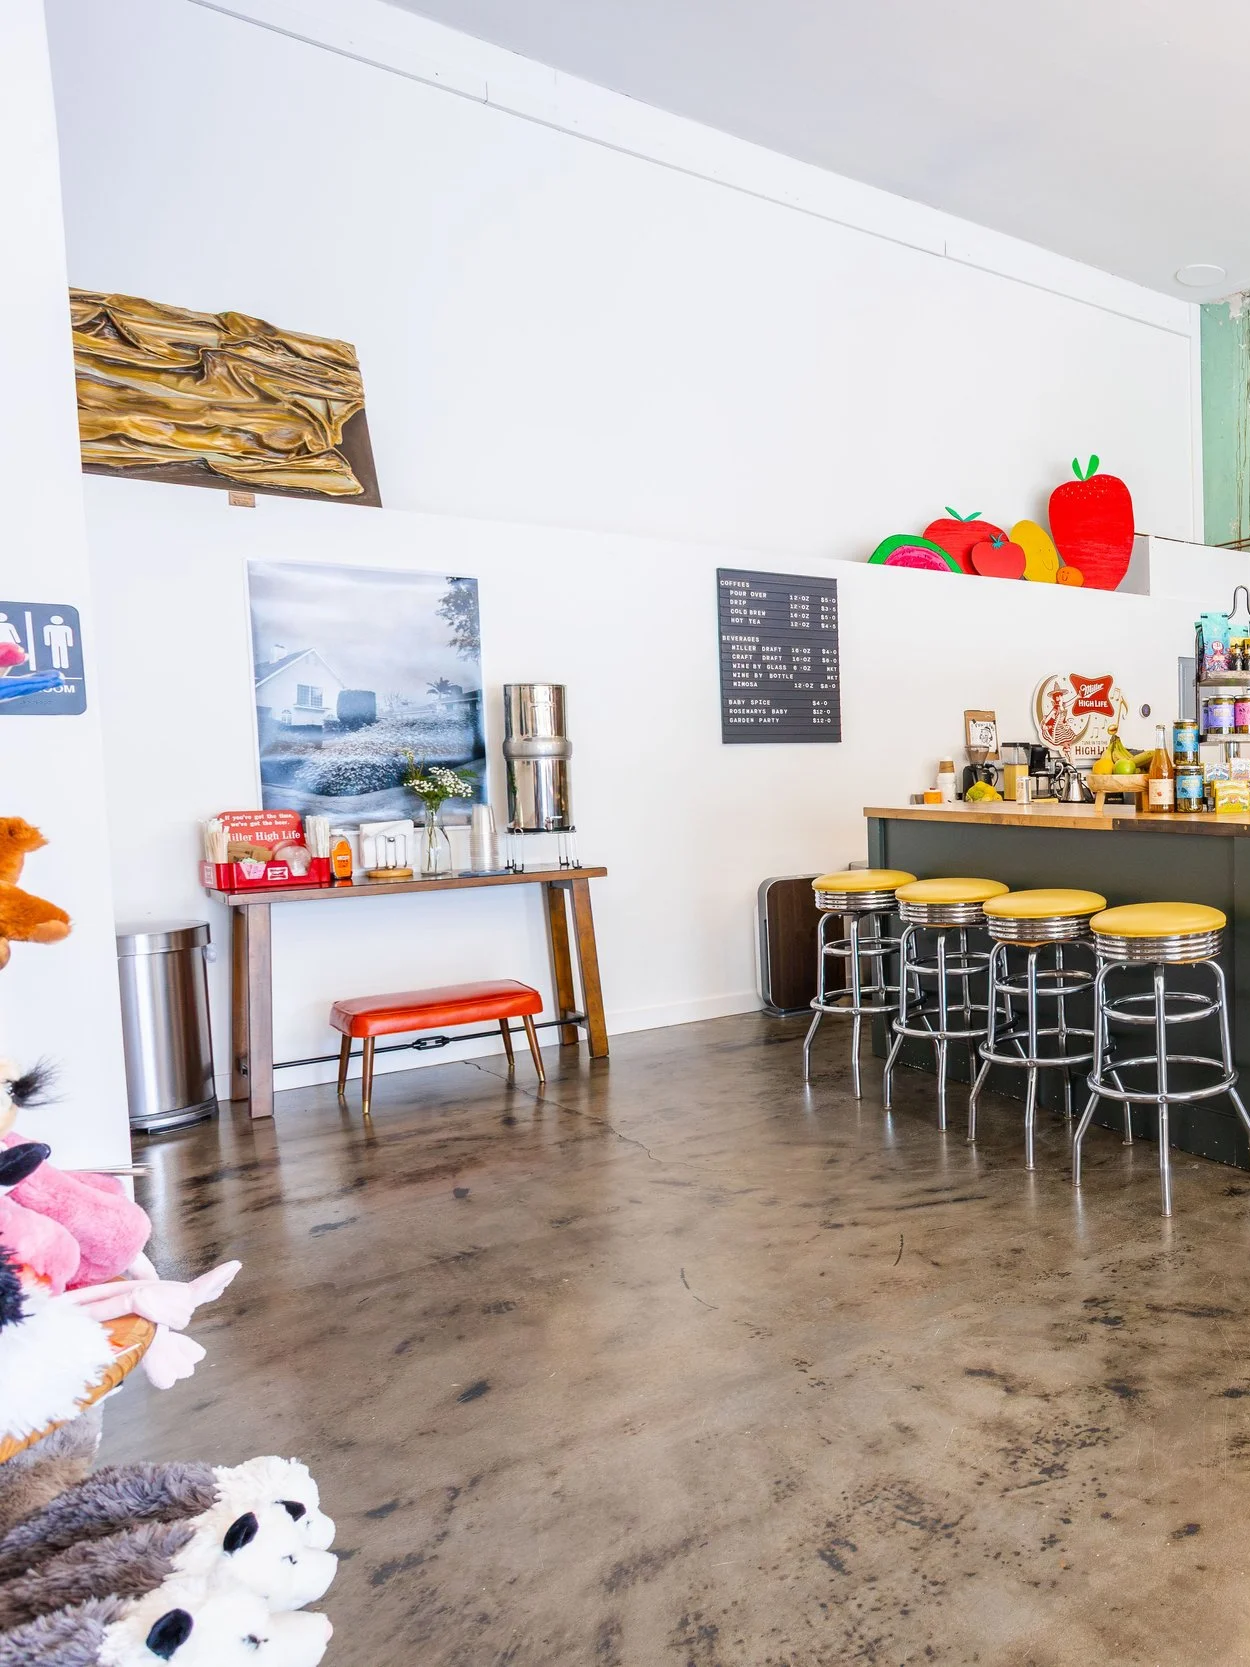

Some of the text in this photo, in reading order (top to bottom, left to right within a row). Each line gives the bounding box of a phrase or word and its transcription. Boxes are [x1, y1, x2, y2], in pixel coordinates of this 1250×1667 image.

[720, 580, 750, 588] COFFEES
[1080, 683, 1104, 698] Miller
[1095, 700, 1108, 708] LIFE
[1075, 746, 1096, 755] HIGH
[255, 830, 300, 842] High Life
